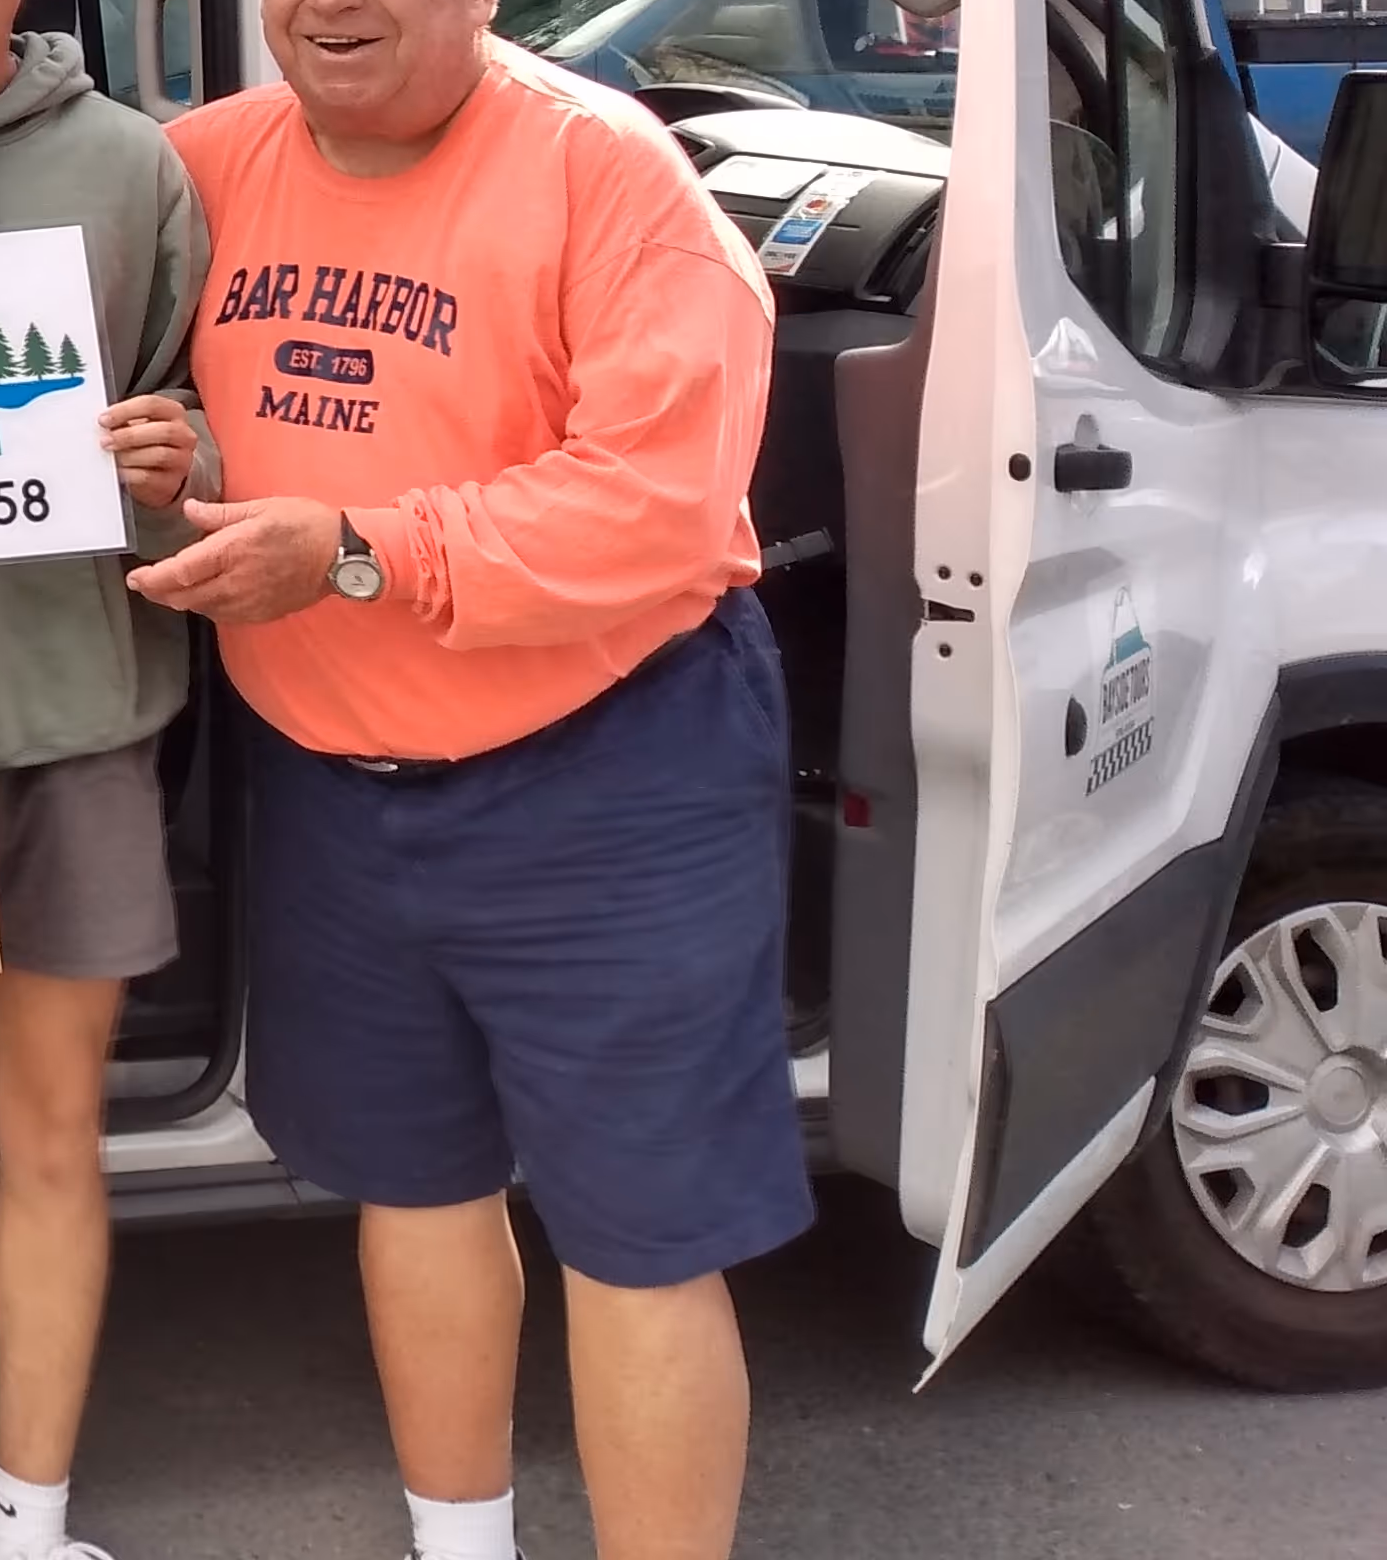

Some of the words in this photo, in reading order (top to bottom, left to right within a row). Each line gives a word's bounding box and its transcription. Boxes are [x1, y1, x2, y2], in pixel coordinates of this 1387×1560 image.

[214, 263, 300, 327] BAR
[301, 265, 458, 358] HARBOR
[288, 348, 322, 370] EST.
[330, 355, 368, 377] 1796
[255, 385, 380, 434] MAINE
